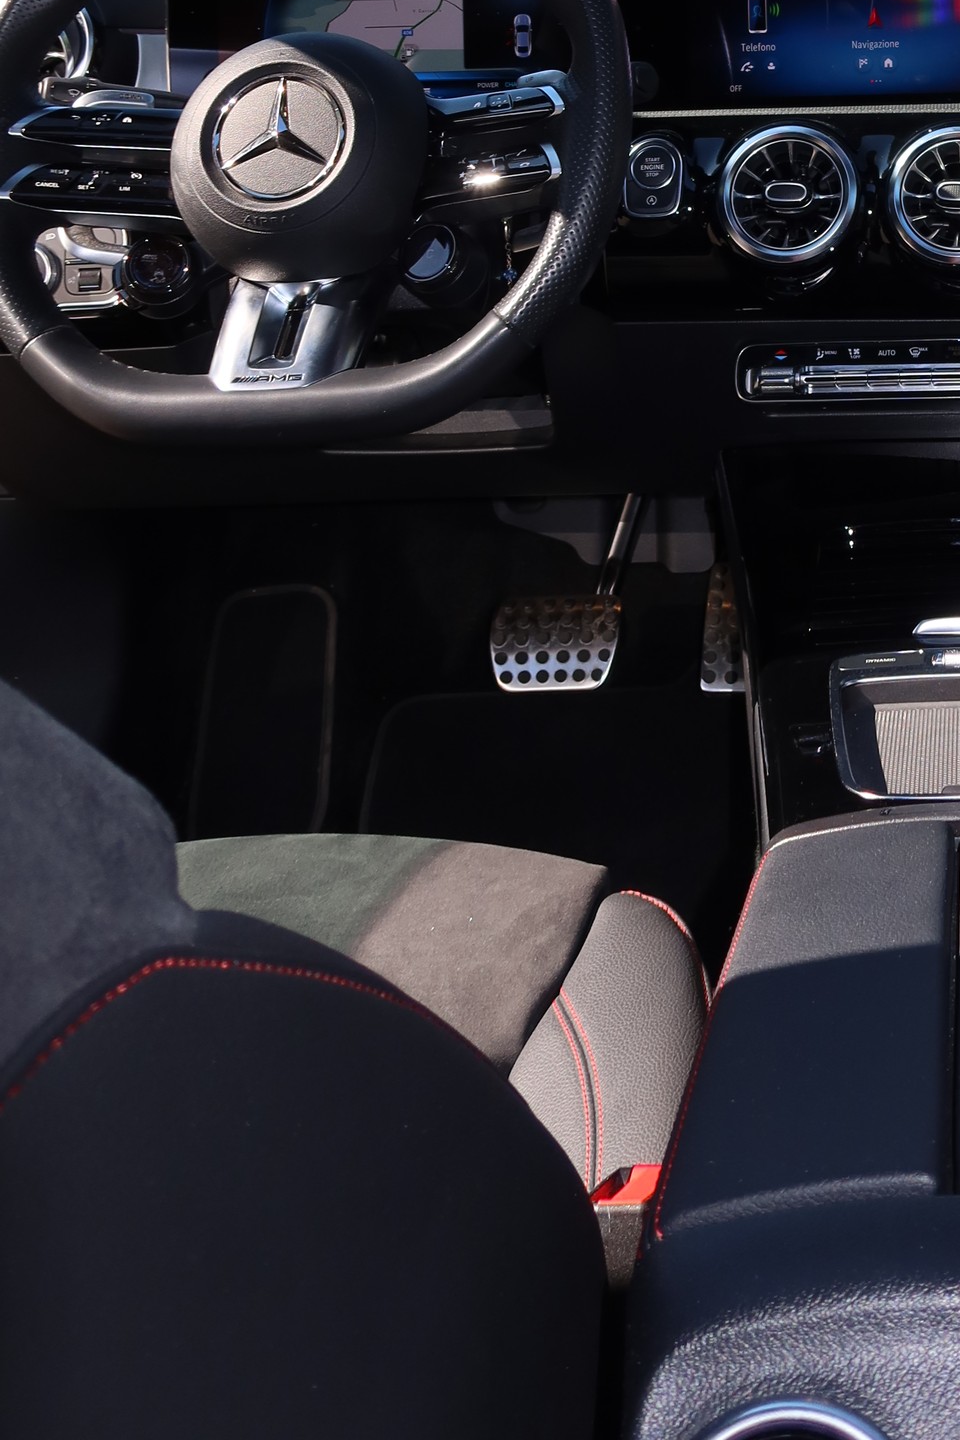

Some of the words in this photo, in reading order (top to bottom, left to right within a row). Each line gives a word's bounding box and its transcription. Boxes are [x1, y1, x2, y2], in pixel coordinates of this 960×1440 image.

[741, 43, 776, 52] Telefono
[851, 40, 900, 51] Navigazione
[729, 85, 742, 93] OFF
[877, 349, 896, 357] AUTO
